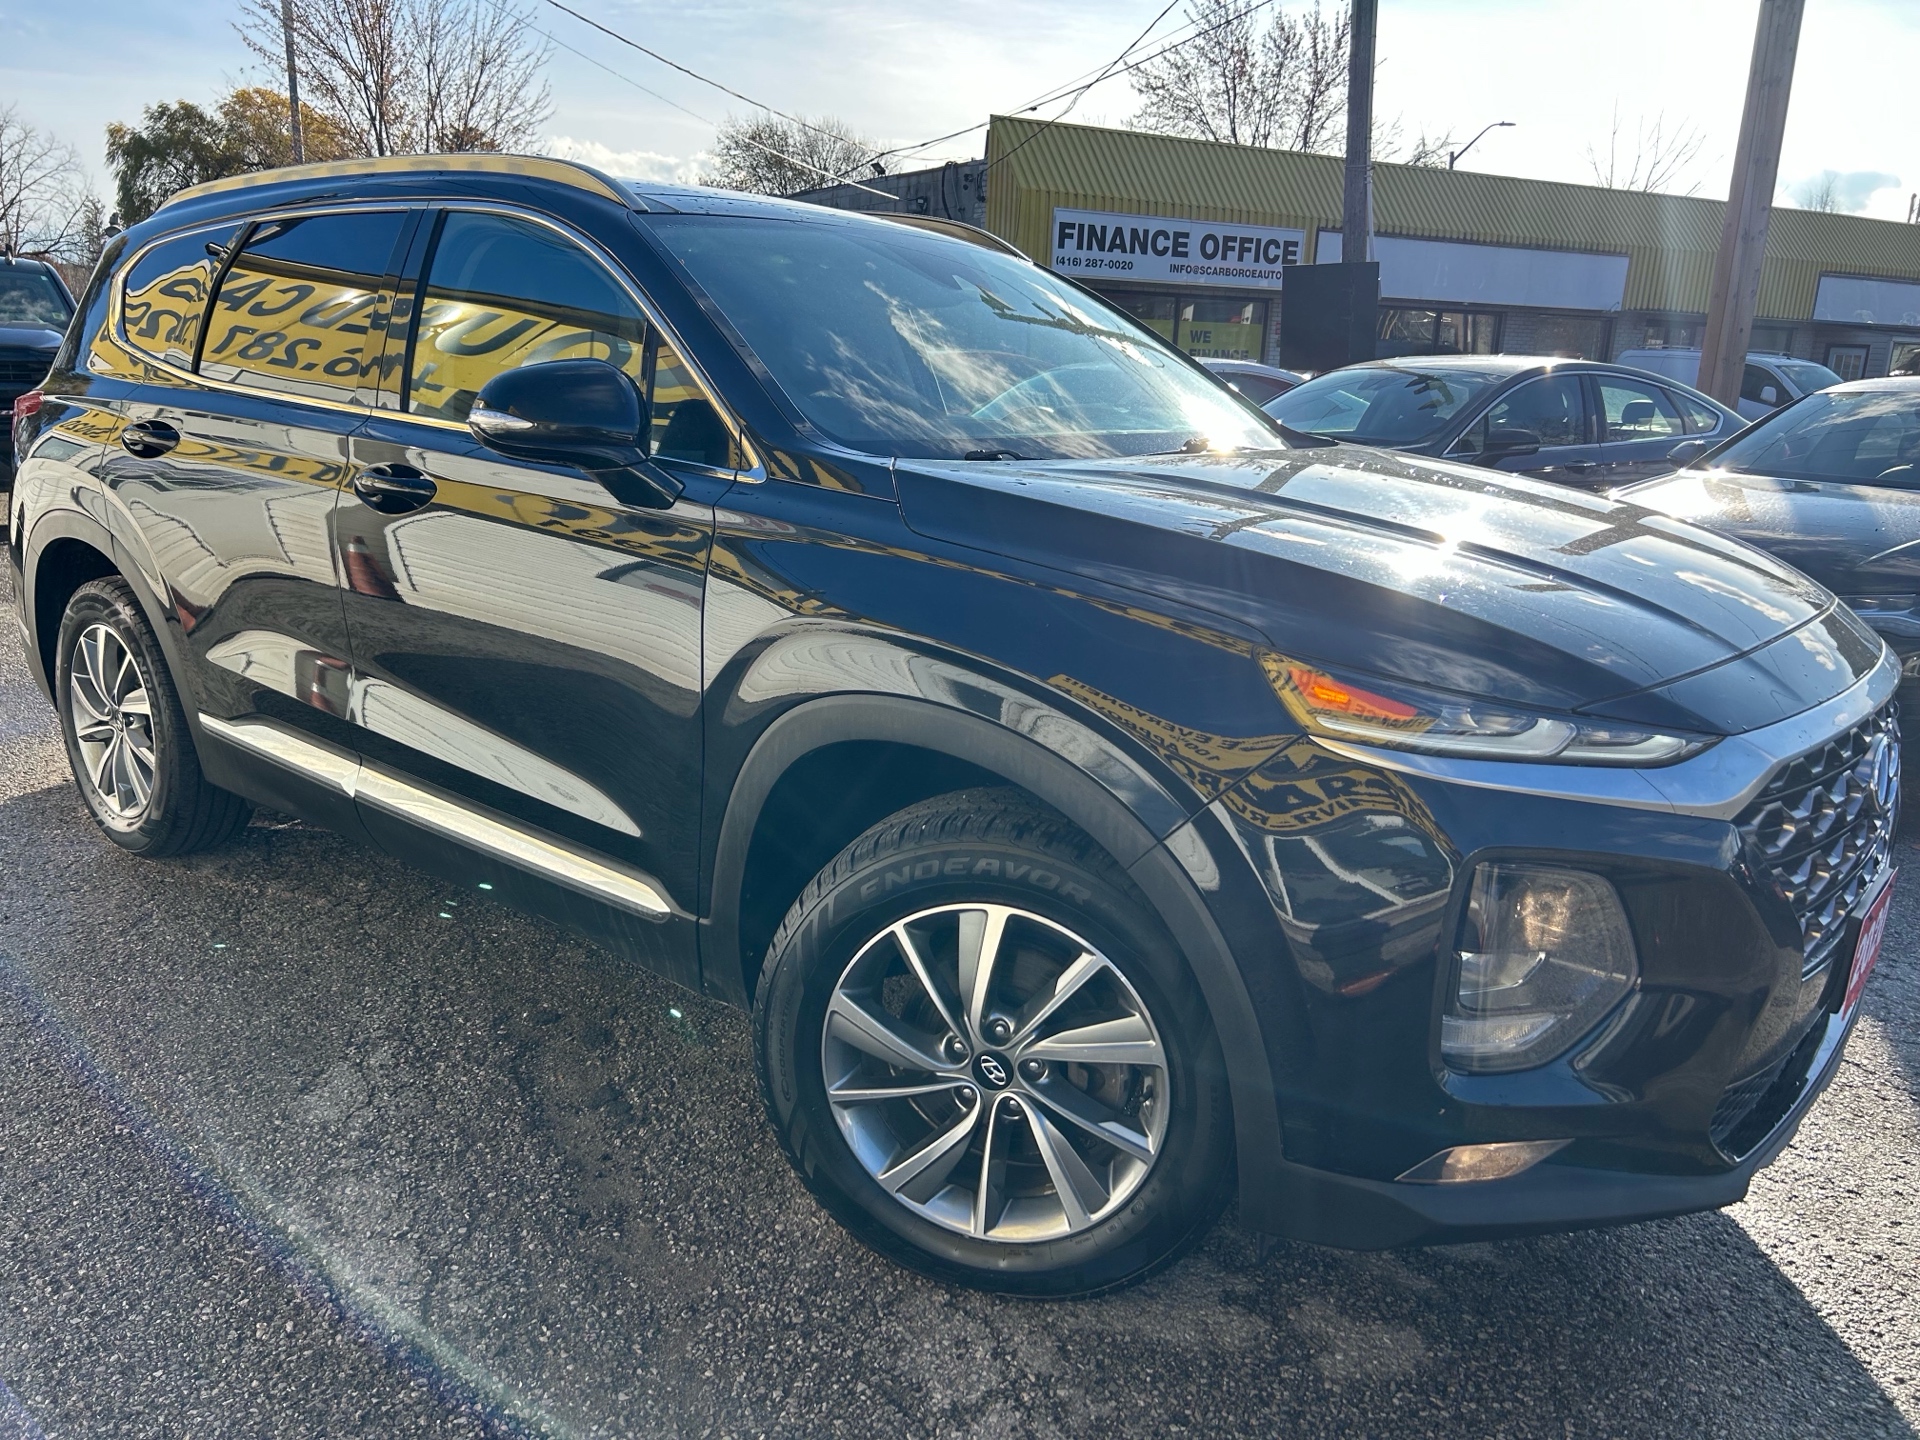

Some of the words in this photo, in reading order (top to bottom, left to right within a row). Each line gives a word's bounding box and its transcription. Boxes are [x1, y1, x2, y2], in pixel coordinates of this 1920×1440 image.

[1058, 222, 1189, 258] FINANCE
[1200, 233, 1299, 265] OFFICE
[1056, 255, 1081, 268] (416)
[1085, 258, 1133, 270] 287-0020
[1190, 330, 1212, 344] WE
[860, 856, 1092, 904] ENDEAVOR
